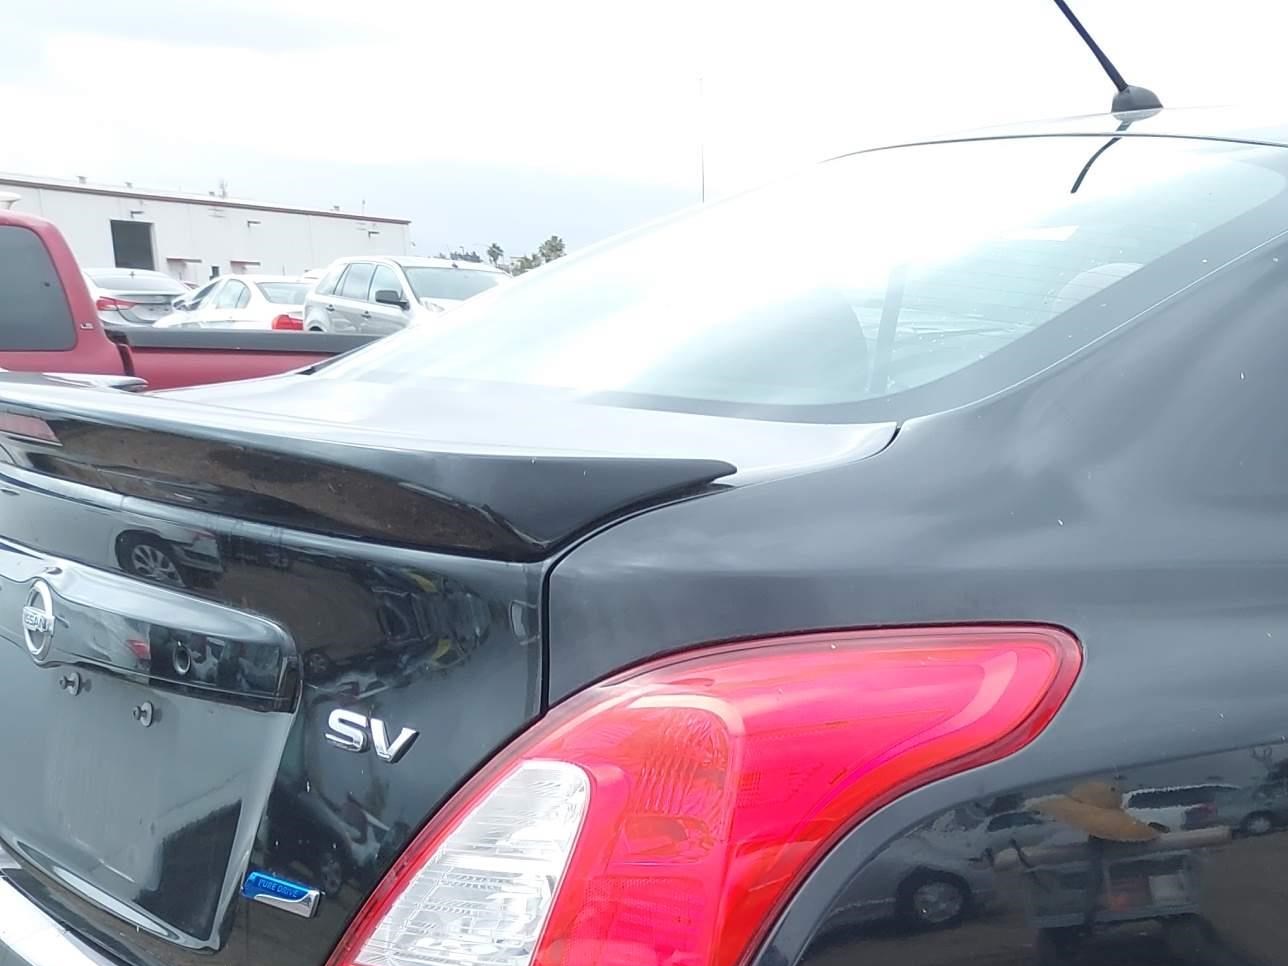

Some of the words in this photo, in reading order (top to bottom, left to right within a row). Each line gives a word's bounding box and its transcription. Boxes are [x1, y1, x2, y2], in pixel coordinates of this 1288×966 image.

[325, 708, 419, 764] SV
[257, 878, 278, 892] PURE
[277, 885, 299, 898] DRIVE
